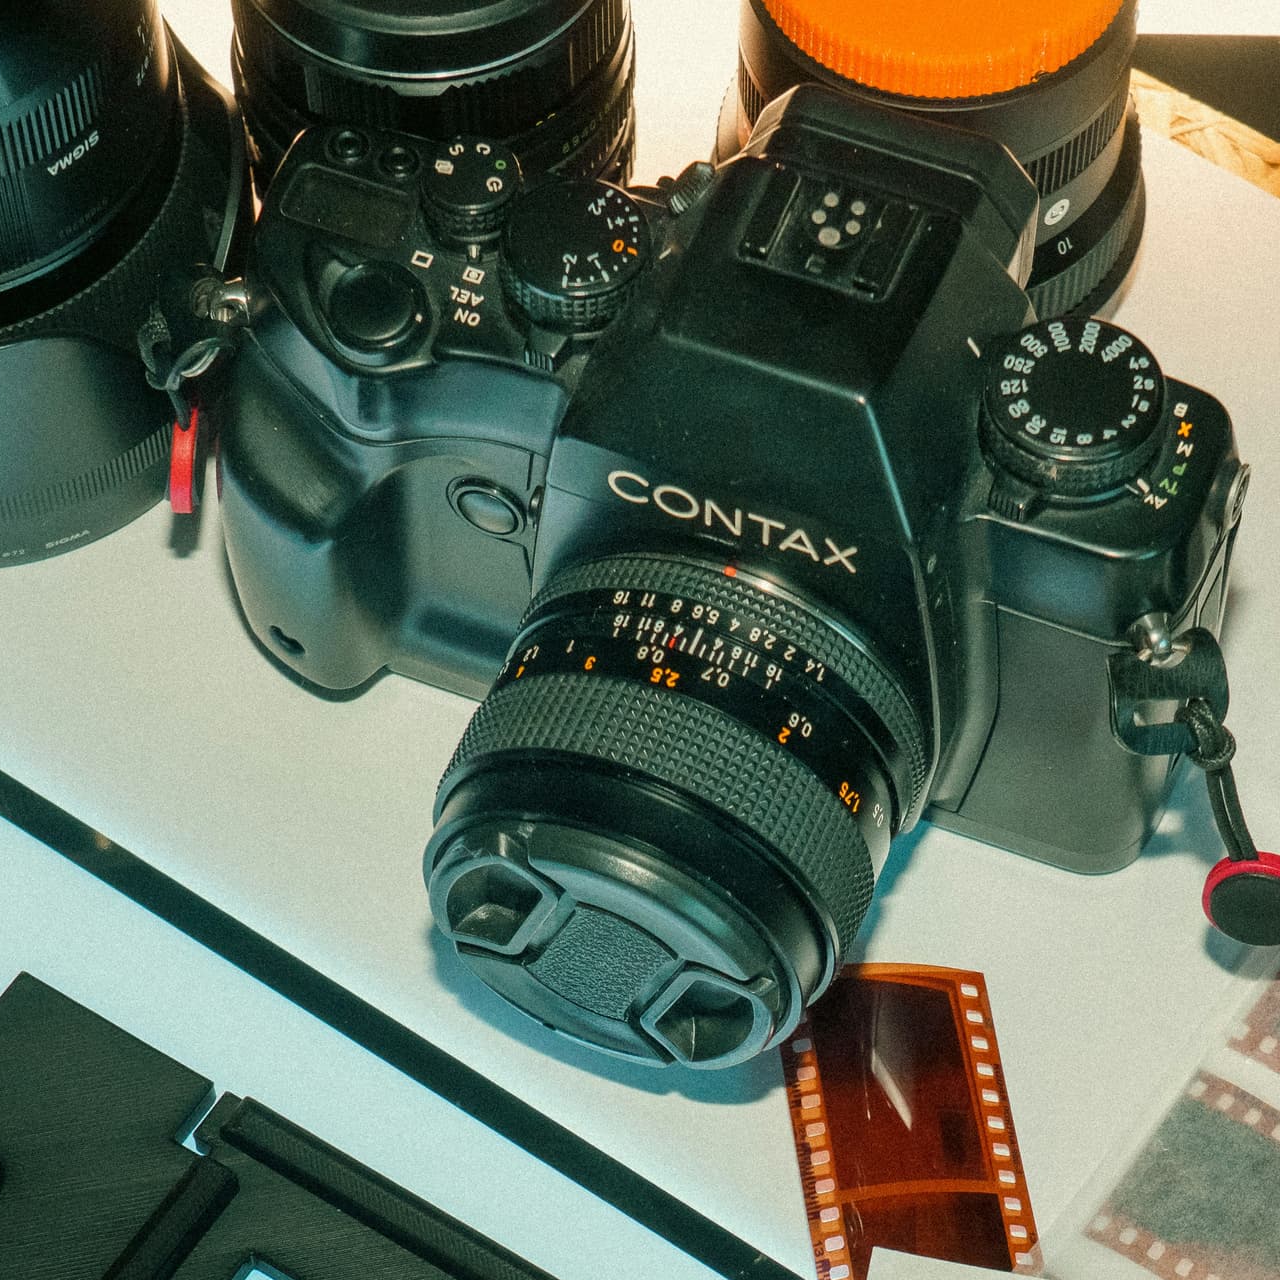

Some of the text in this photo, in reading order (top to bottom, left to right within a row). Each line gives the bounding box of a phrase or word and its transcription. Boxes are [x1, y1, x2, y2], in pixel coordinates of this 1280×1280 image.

[47, 130, 100, 176] SIGMA
[476, 143, 491, 156] C
[1058, 236, 1073, 255] 10
[450, 285, 485, 308] AEL
[453, 307, 481, 327] ON
[1020, 333, 1048, 359] 500
[1047, 322, 1072, 352] 1000
[1078, 321, 1101, 355] 2000
[1100, 334, 1133, 363] 4000
[1003, 354, 1036, 374] 250
[1000, 378, 1029, 396] 125
[1008, 398, 1031, 419] 60
[1173, 402, 1189, 418] B
[1025, 414, 1047, 435] 30
[1049, 427, 1068, 445] 15
[1176, 440, 1194, 457] M
[1172, 462, 1188, 477] P
[1144, 495, 1168, 510] Av
[607, 468, 858, 576] CONTAX
[45, 529, 91, 550] SIGMA
[613, 590, 631, 605] 16
[640, 592, 656, 609] 11
[671, 599, 683, 613] 8
[729, 617, 741, 632] 4
[783, 644, 797, 662] 2
[613, 614, 631, 628] 16
[638, 617, 652, 631] 11
[653, 620, 665, 633] 8
[730, 646, 743, 660] 8
[744, 652, 759, 669] 11
[765, 663, 784, 682] 16
[584, 655, 597, 671] 3
[777, 726, 792, 744] 2
[813, 1239, 824, 1258] 13
